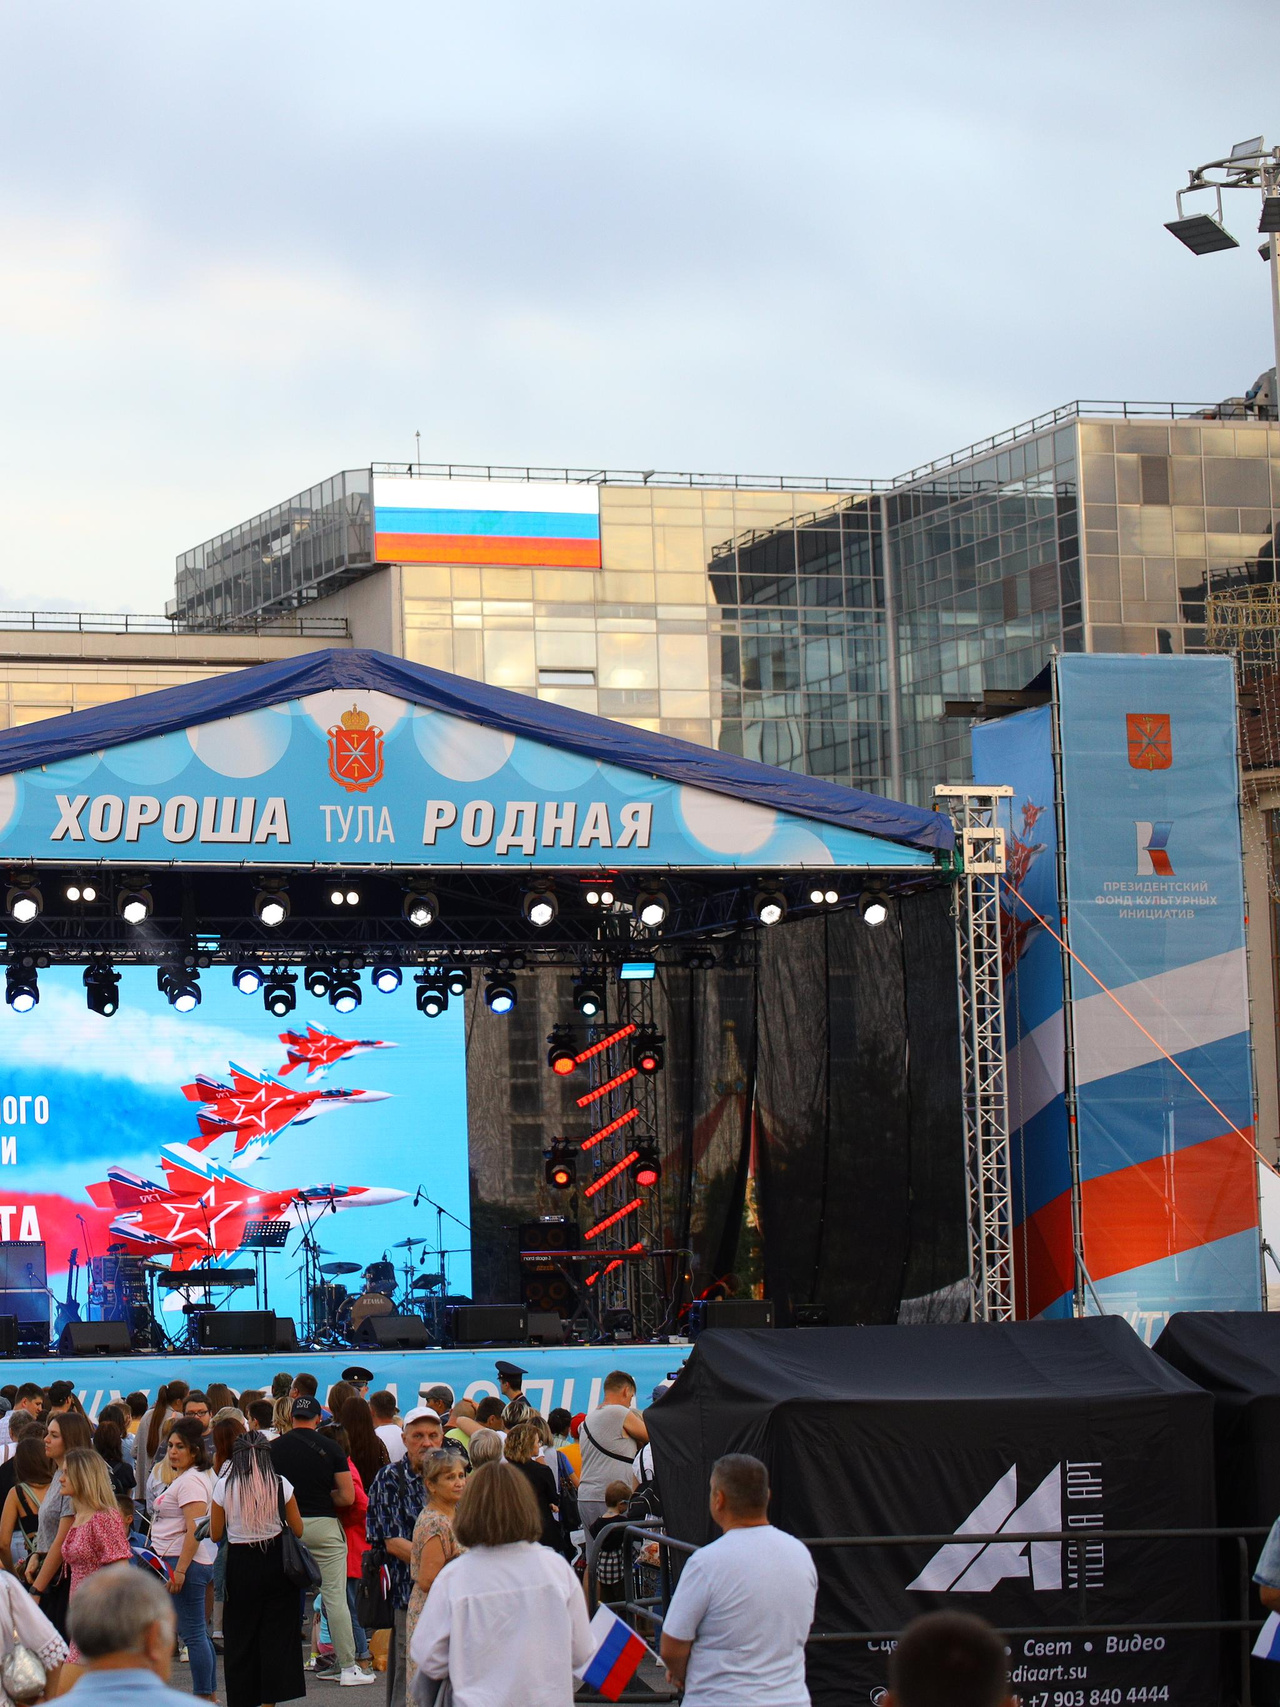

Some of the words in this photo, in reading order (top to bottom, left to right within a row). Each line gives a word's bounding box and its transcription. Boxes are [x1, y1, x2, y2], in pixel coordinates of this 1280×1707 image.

[49, 794, 291, 844] ХОРОША
[319, 805, 395, 844] ТУЛА
[423, 799, 655, 856] РОДНАЯ
[1103, 880, 1209, 893] ПРЕЗИДЕНТСКИЙ
[1094, 895, 1133, 906] ФОНД
[1136, 895, 1218, 906] КУЛЬТУРНЫХ
[1119, 909, 1196, 919] ИНИЦИАТИВ
[296, 1398, 311, 1408] NY
[1066, 1460, 1103, 1499] АРТ
[1023, 1639, 1072, 1656] Свет
[1106, 1633, 1166, 1653] Видео
[1029, 1692, 1048, 1707] +7
[1053, 1690, 1085, 1707] 903
[1089, 1688, 1121, 1705] 840
[1126, 1684, 1170, 1703] 4444
